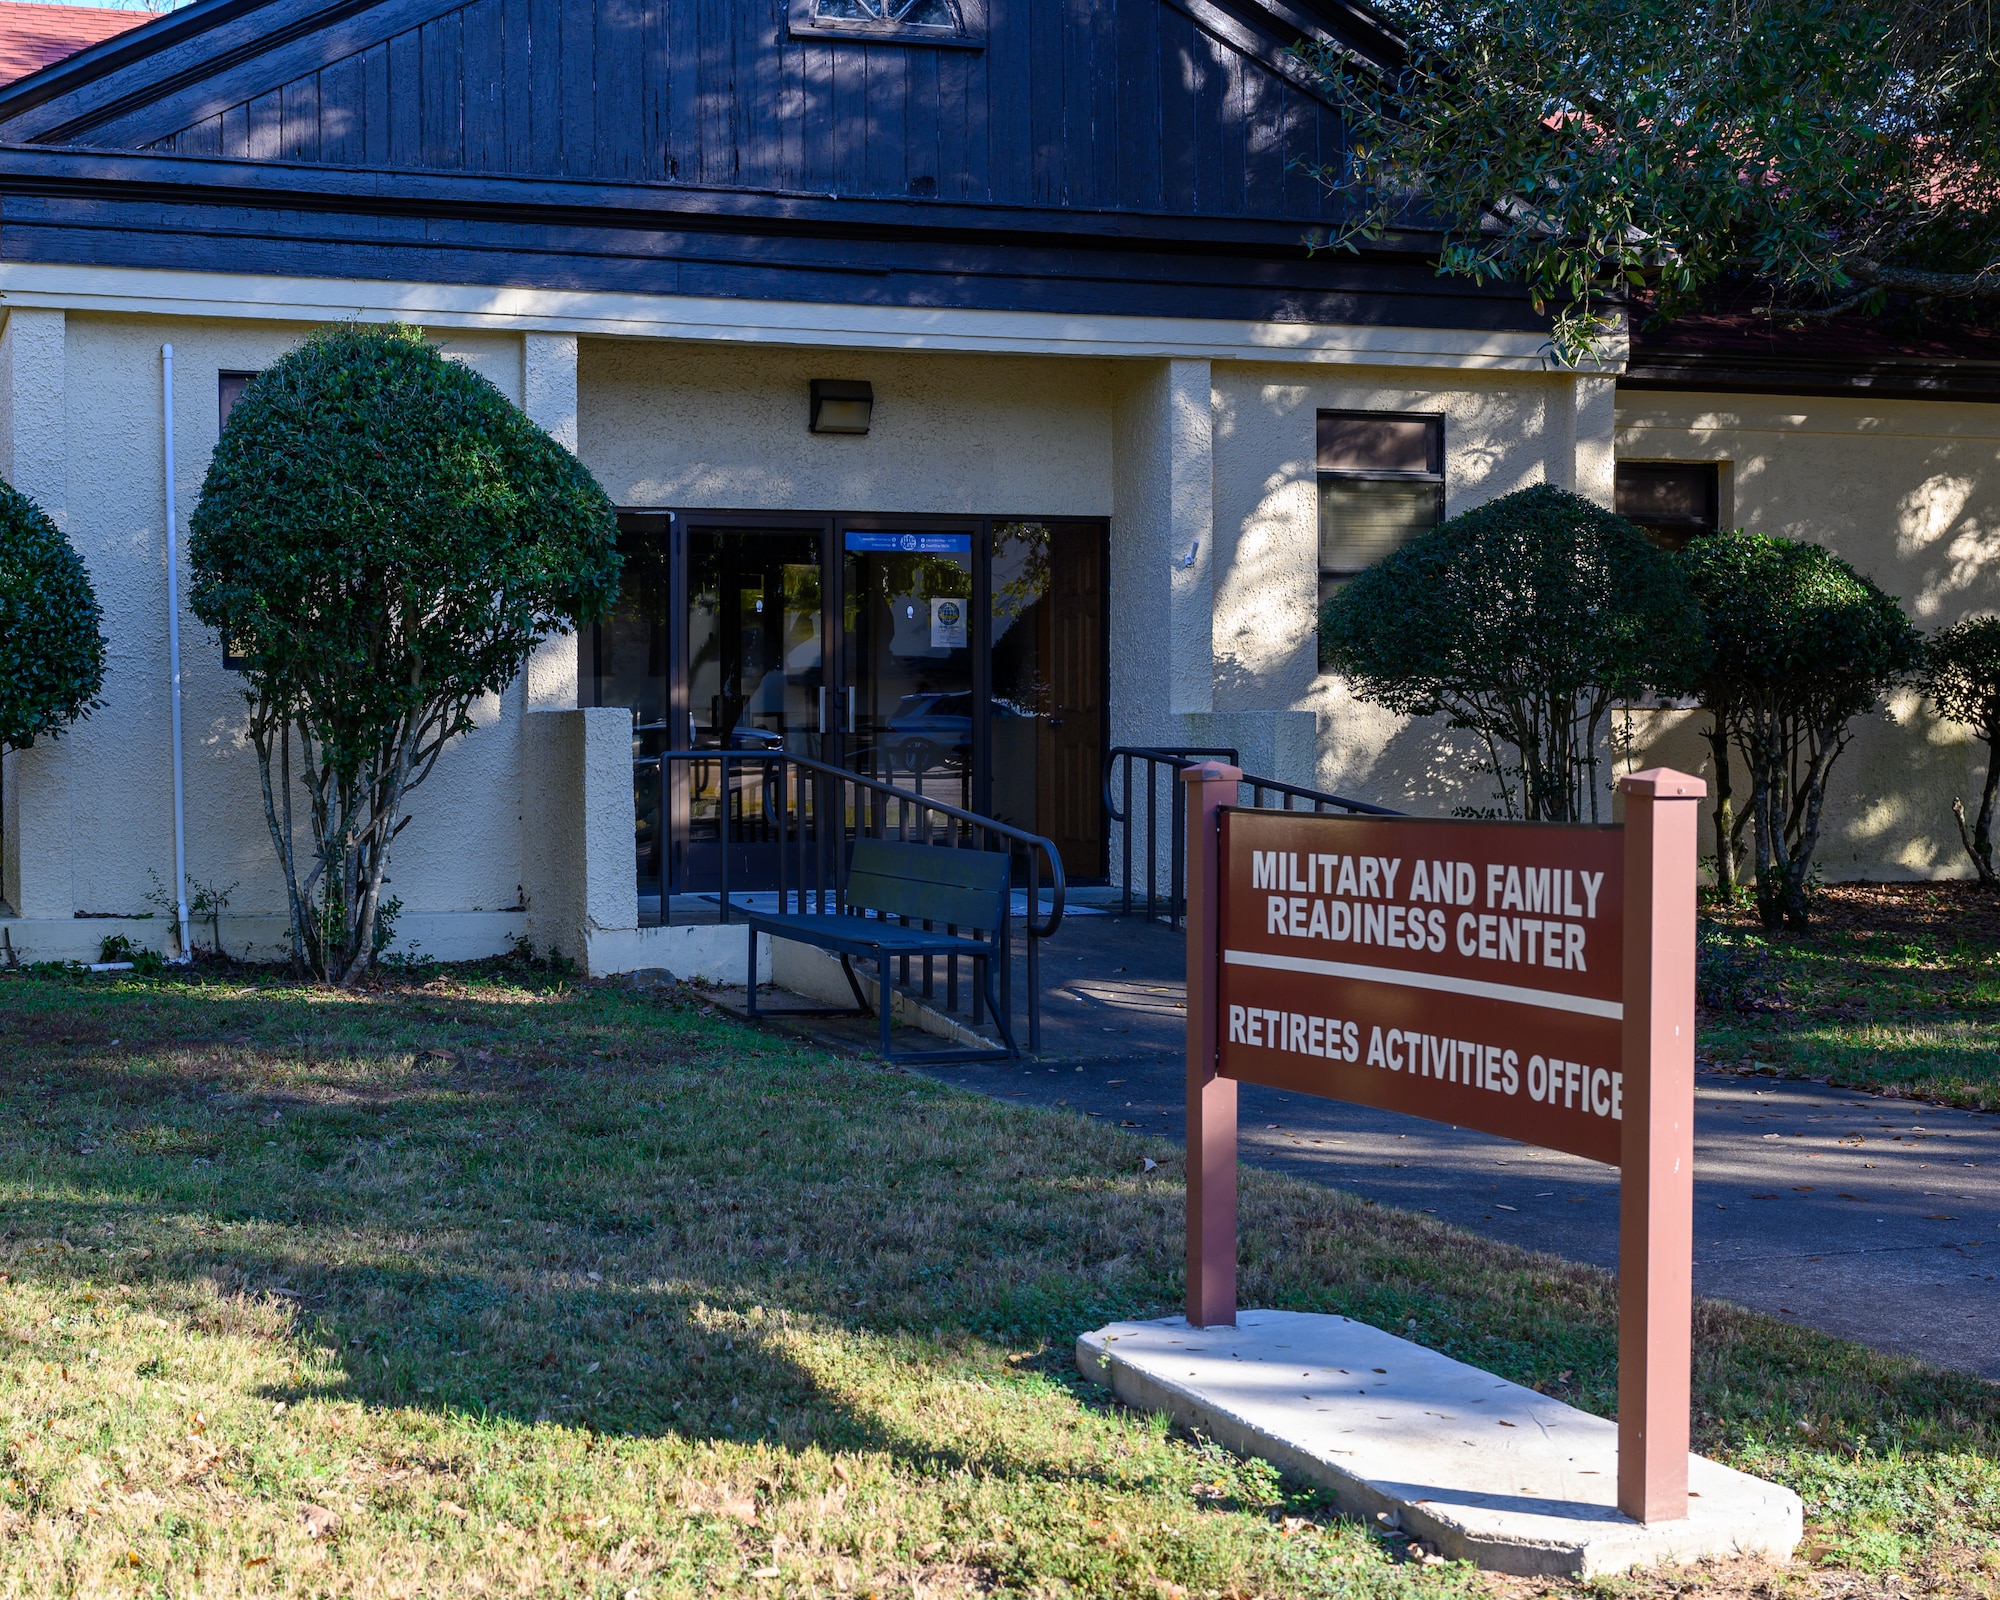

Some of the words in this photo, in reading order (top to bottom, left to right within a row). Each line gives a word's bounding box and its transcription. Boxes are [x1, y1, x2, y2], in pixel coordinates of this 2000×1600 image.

[1252, 850, 1401, 899] MILITARY
[1409, 859, 1476, 906] AND
[1486, 864, 1604, 919] FAMILY
[1267, 895, 1446, 953] READINESS
[1456, 912, 1587, 972] CENTER
[1229, 1004, 1359, 1063] RETIREES
[1366, 1025, 1519, 1096] ACTIVITIES
[1527, 1054, 1623, 1121] OFFICE
